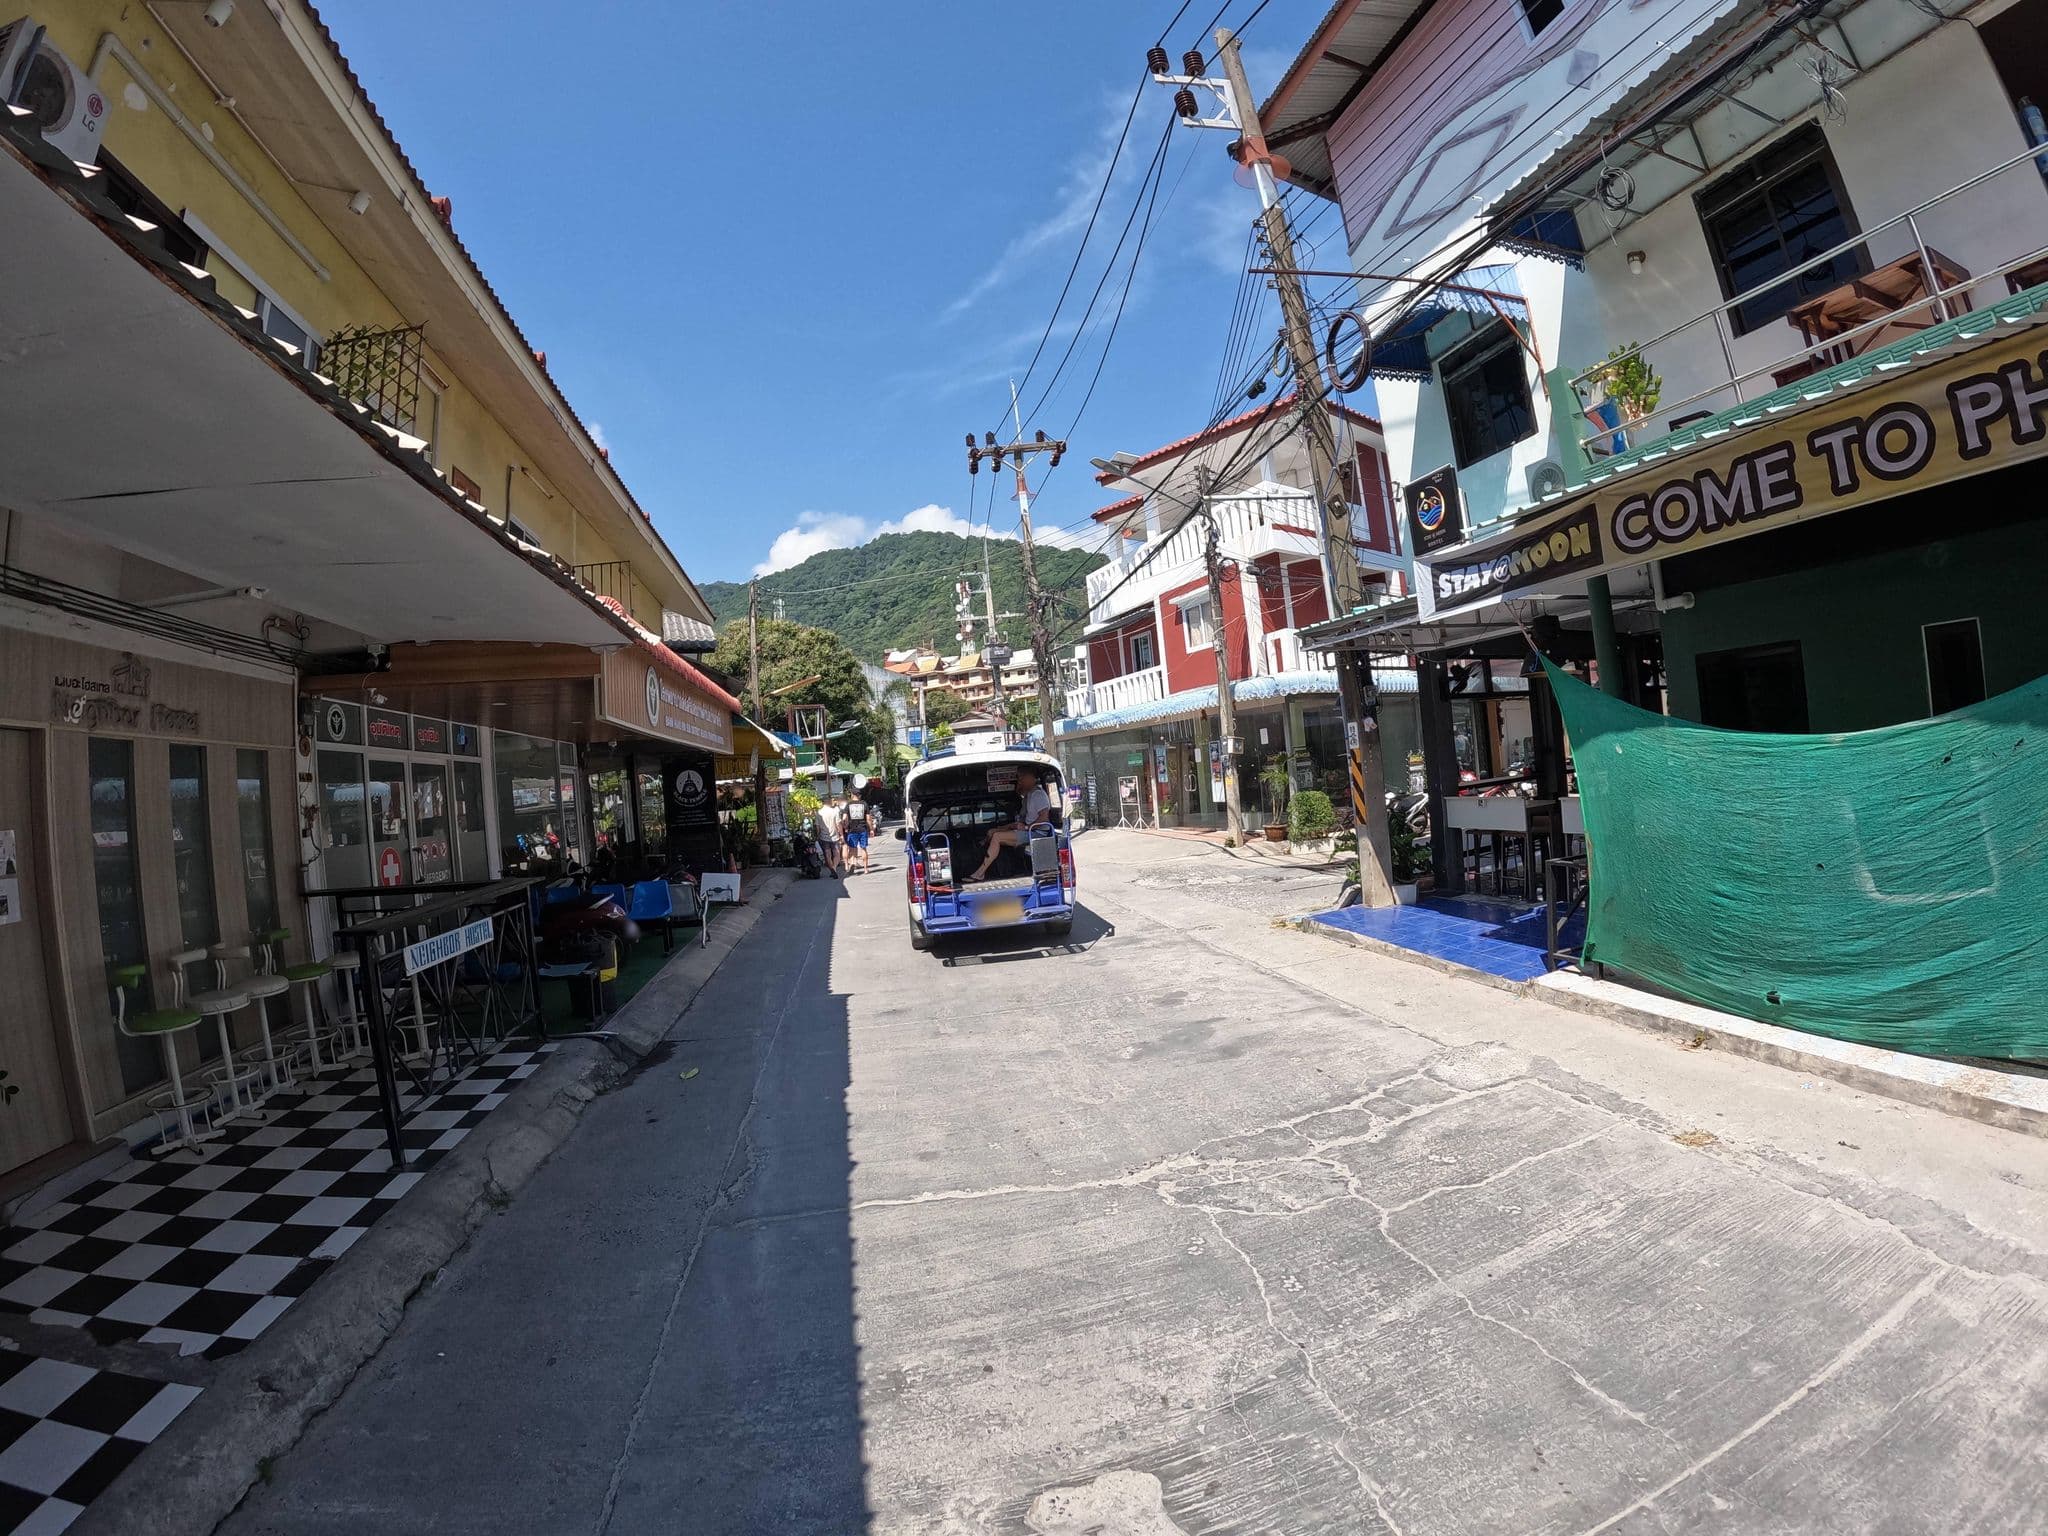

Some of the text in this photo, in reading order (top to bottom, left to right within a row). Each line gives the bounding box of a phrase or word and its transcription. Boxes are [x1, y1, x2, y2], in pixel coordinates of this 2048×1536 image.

[82, 114, 95, 132] LG
[1612, 440, 1803, 554] COME
[1807, 401, 1936, 497] TO
[410, 920, 491, 970] NEIGHBOR HOSTEL
